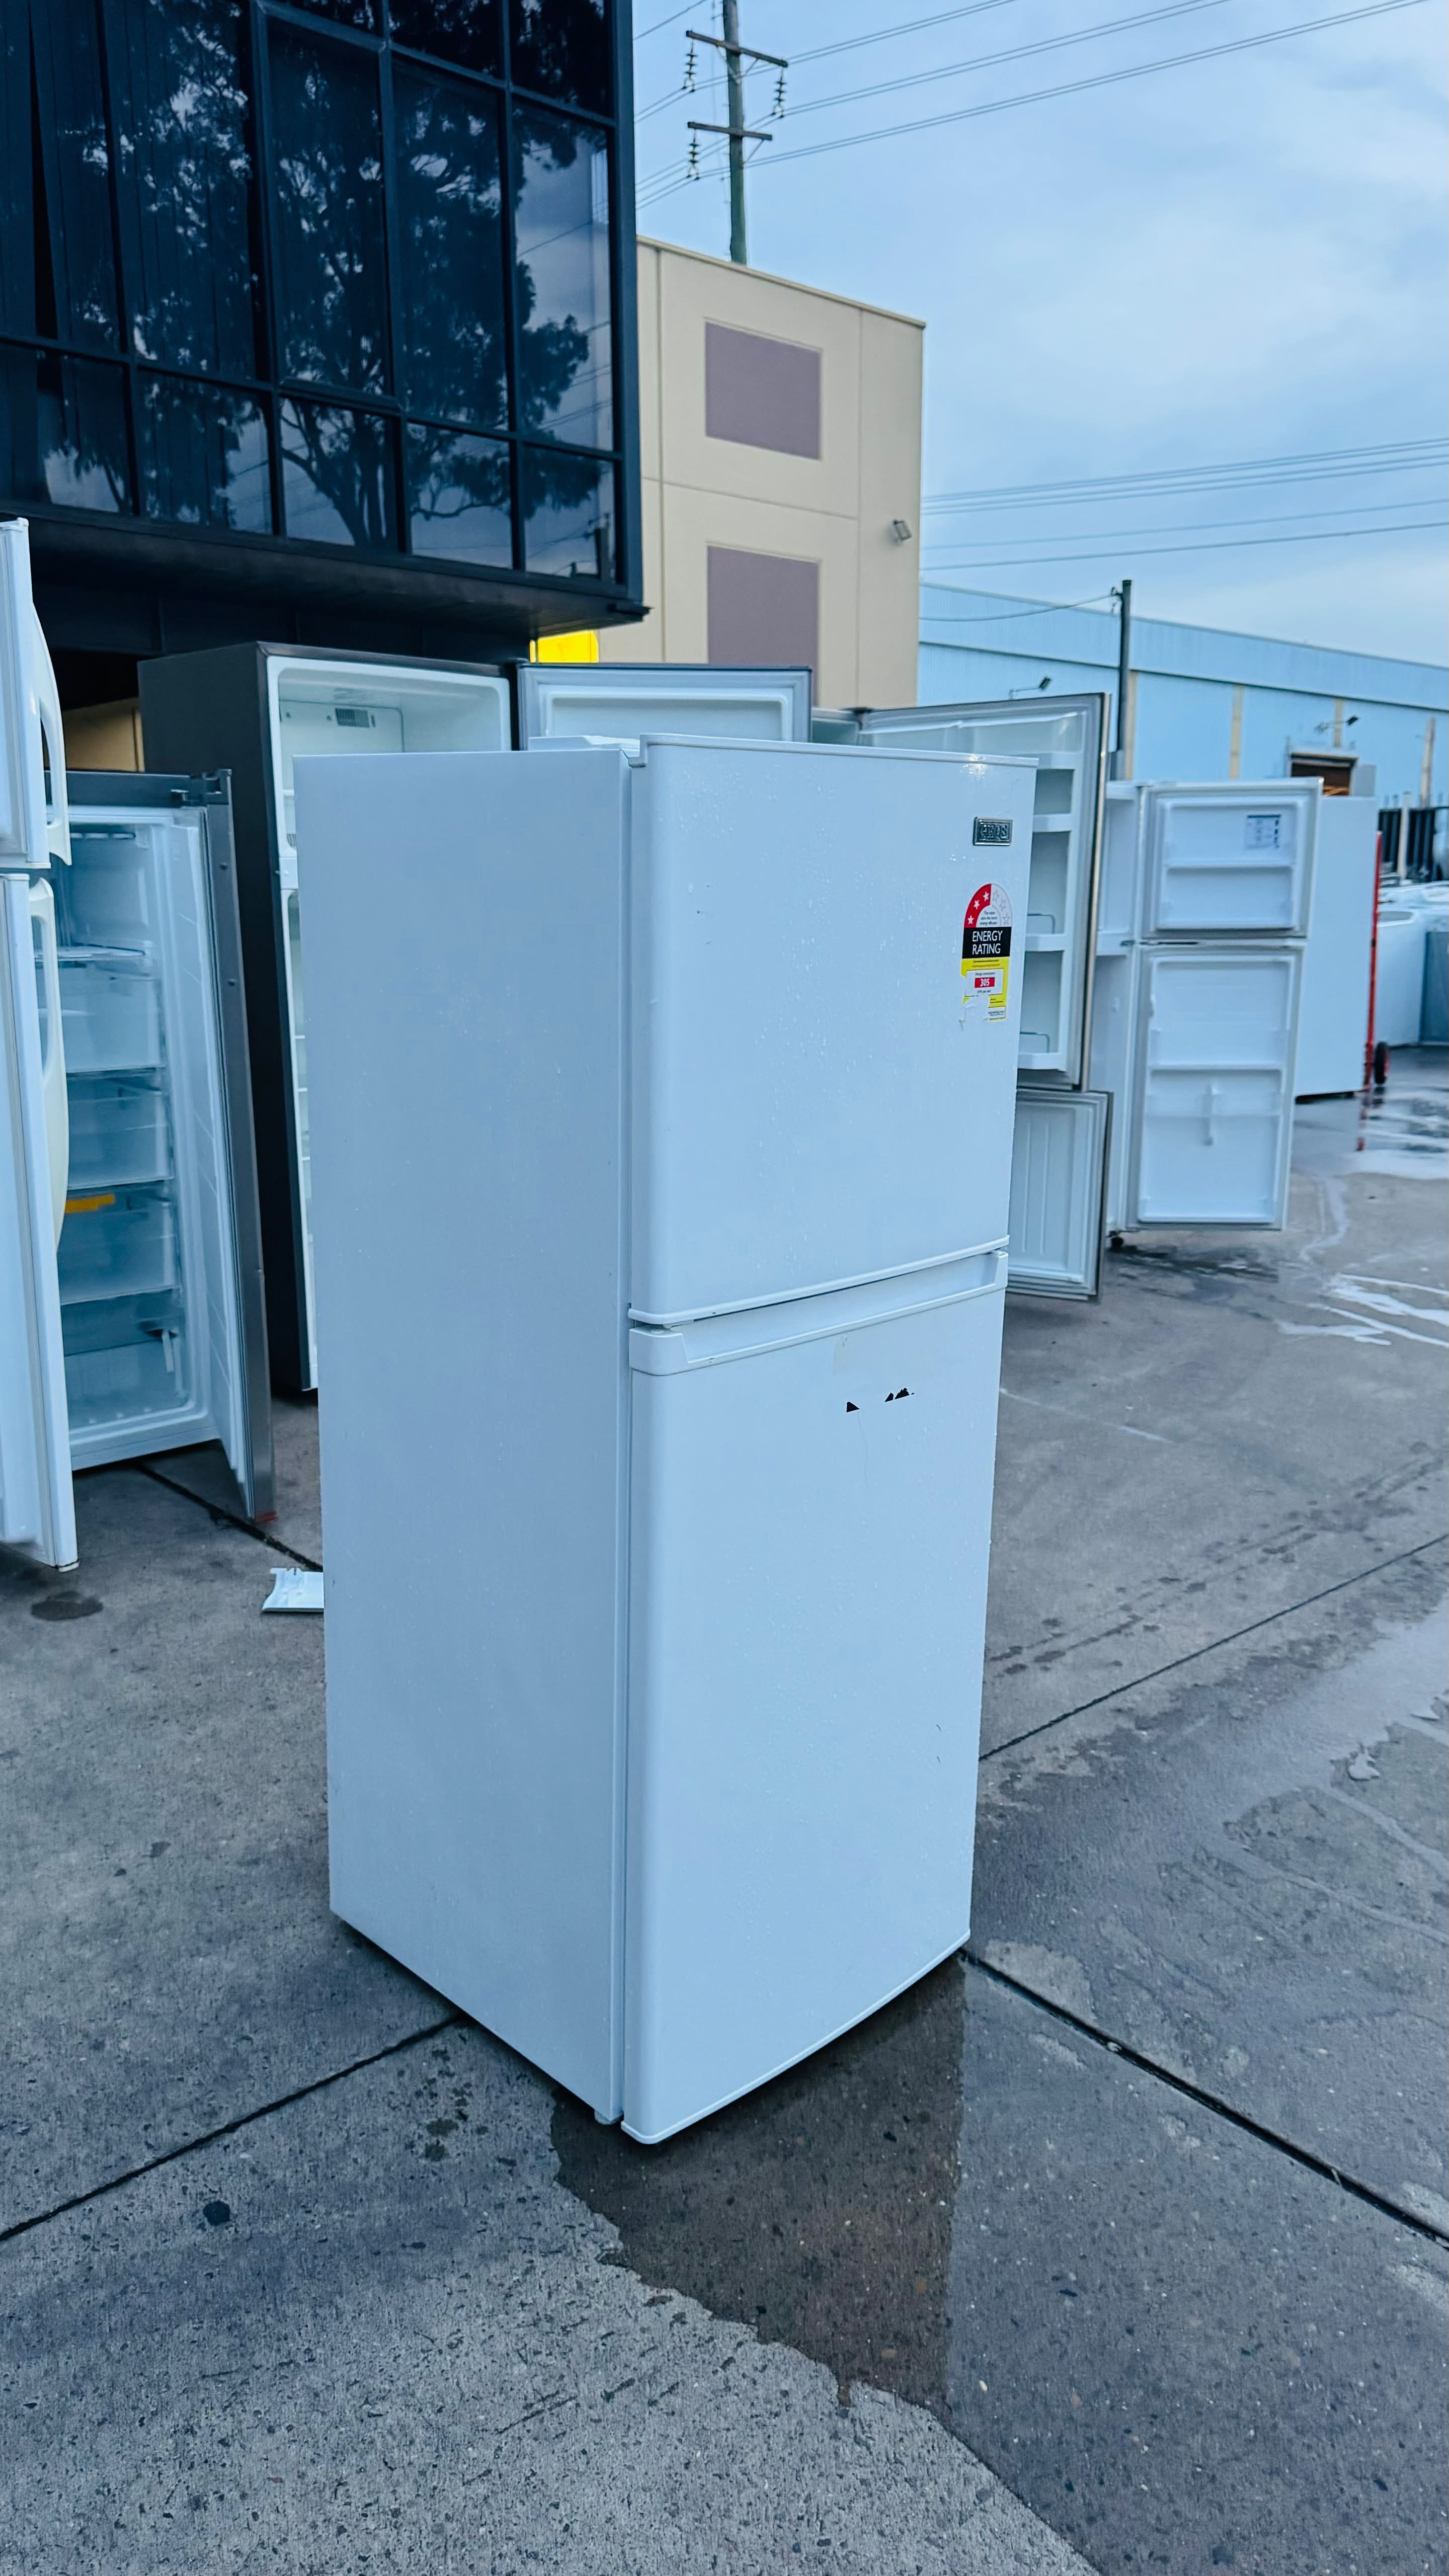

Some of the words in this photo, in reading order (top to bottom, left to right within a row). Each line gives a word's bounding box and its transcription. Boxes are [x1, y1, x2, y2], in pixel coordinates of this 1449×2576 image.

[972, 930, 1003, 942] ENERGY
[972, 943, 1001, 955] RATING
[980, 978, 990, 987] 305
